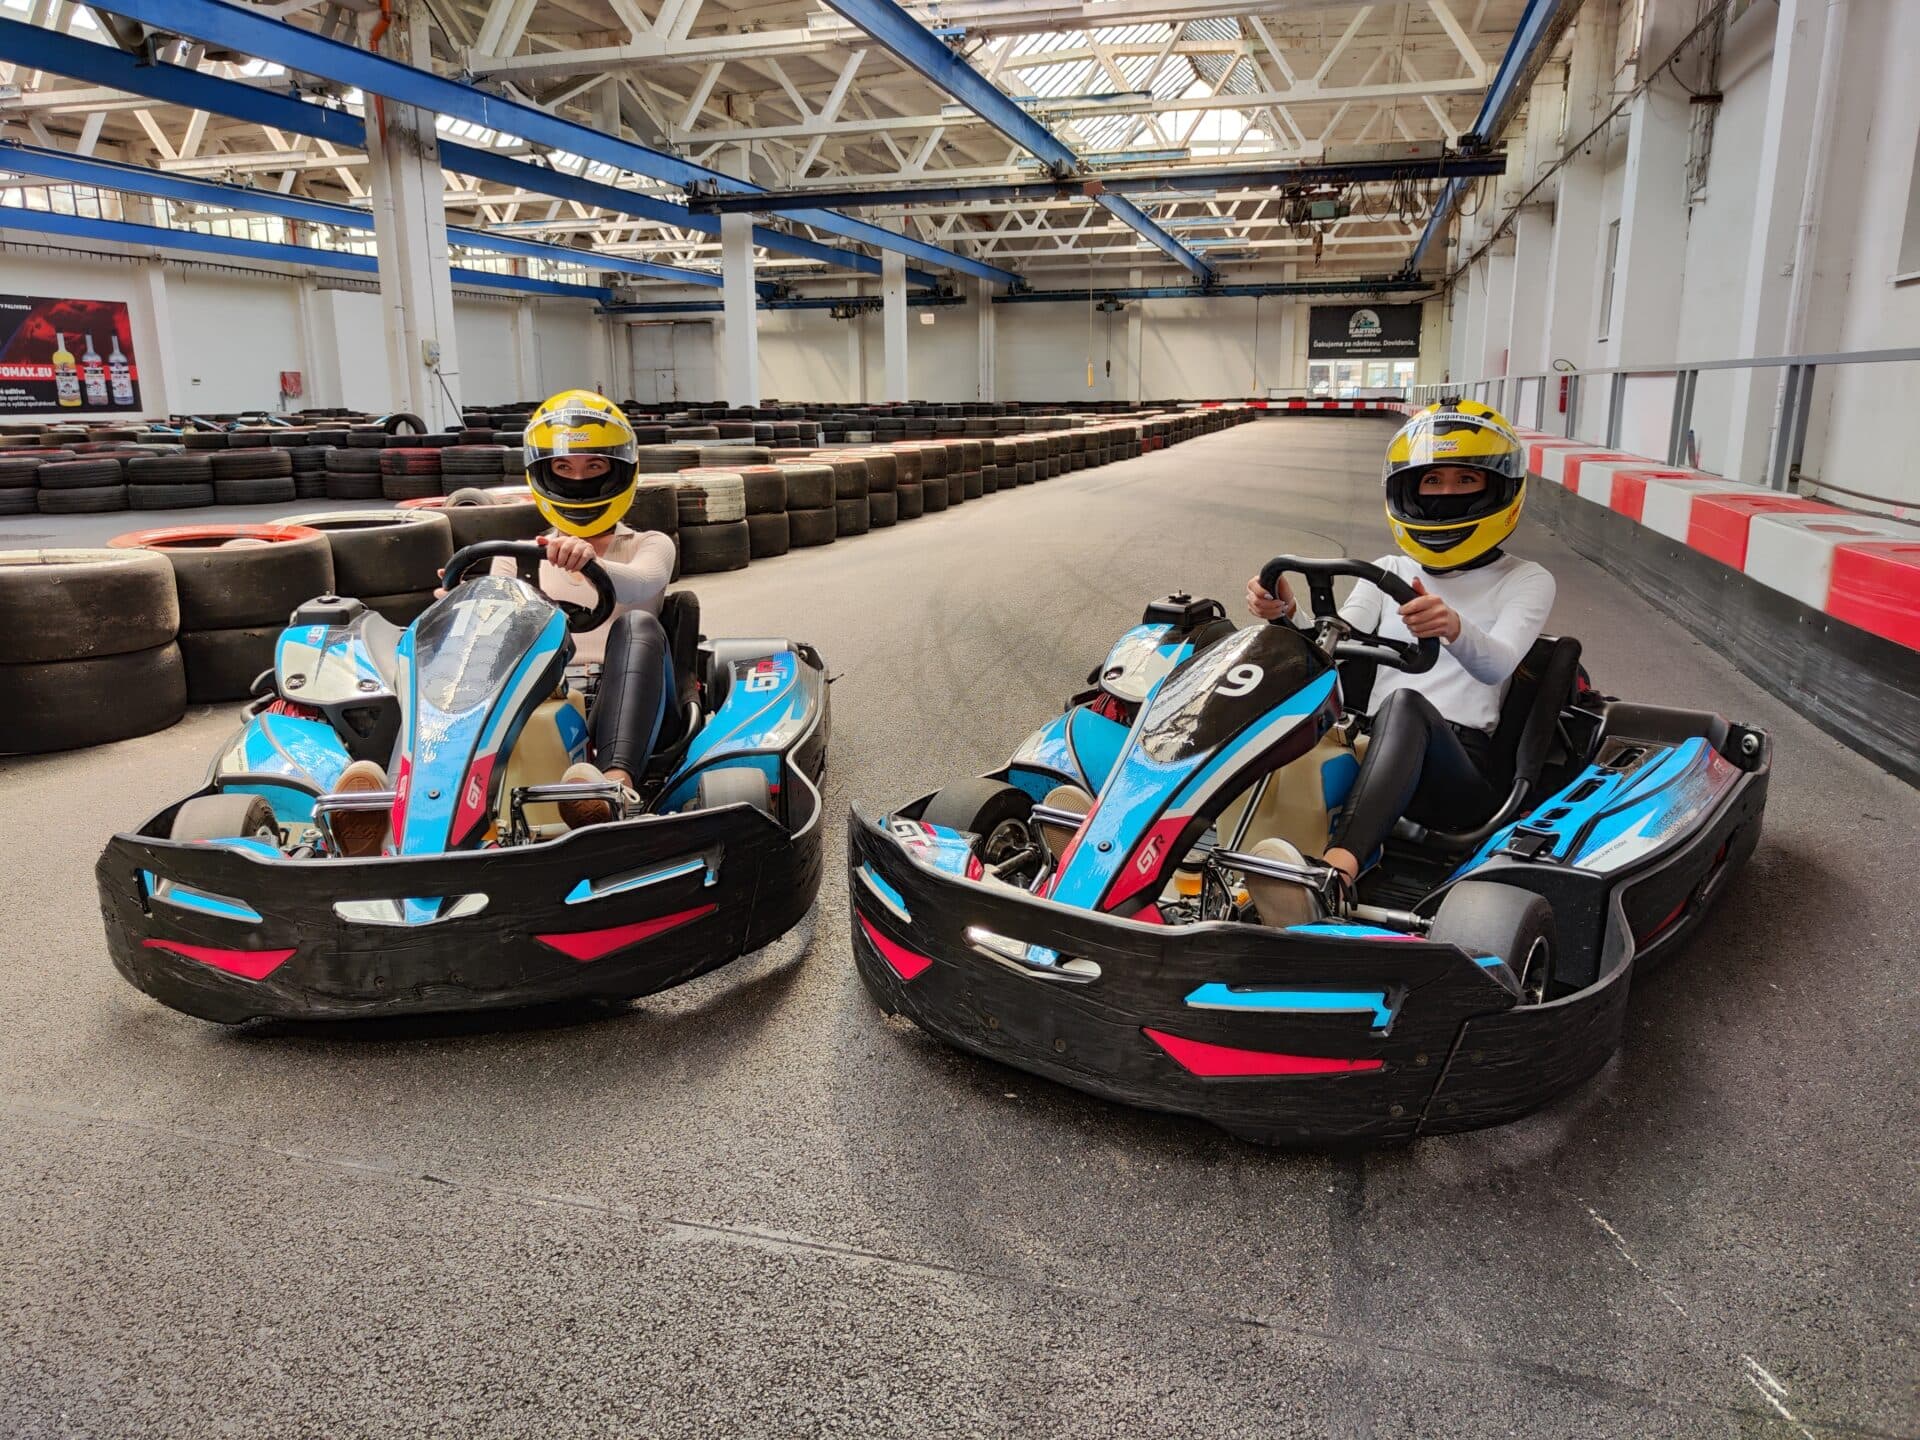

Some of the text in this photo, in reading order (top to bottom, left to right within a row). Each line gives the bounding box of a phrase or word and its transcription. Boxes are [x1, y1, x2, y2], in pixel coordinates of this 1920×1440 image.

[1348, 327, 1382, 335] KARTING
[0, 366, 53, 378] OMAX.EU
[452, 599, 517, 637] 17
[1214, 663, 1265, 697] 9
[466, 773, 483, 810] GTR
[1136, 833, 1165, 874] GTR
